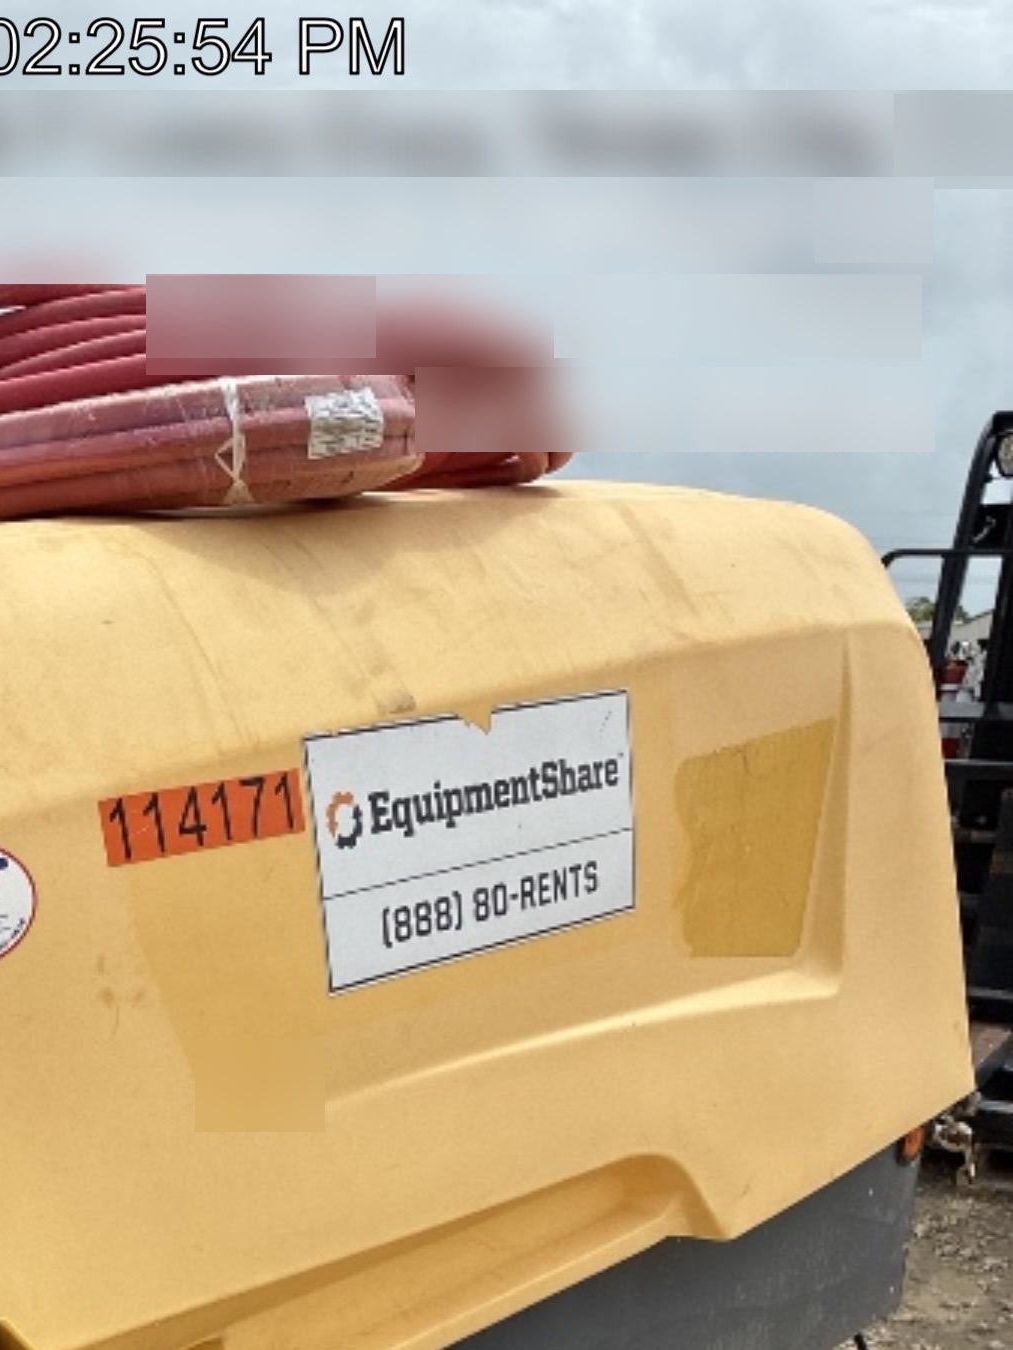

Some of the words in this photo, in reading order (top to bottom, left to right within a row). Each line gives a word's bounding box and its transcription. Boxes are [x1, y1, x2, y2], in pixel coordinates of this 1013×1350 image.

[108, 770, 296, 860] 114171
[368, 758, 620, 837] EquipmentShare
[382, 890, 463, 948] (888)
[472, 860, 599, 922] 80-RENTS
